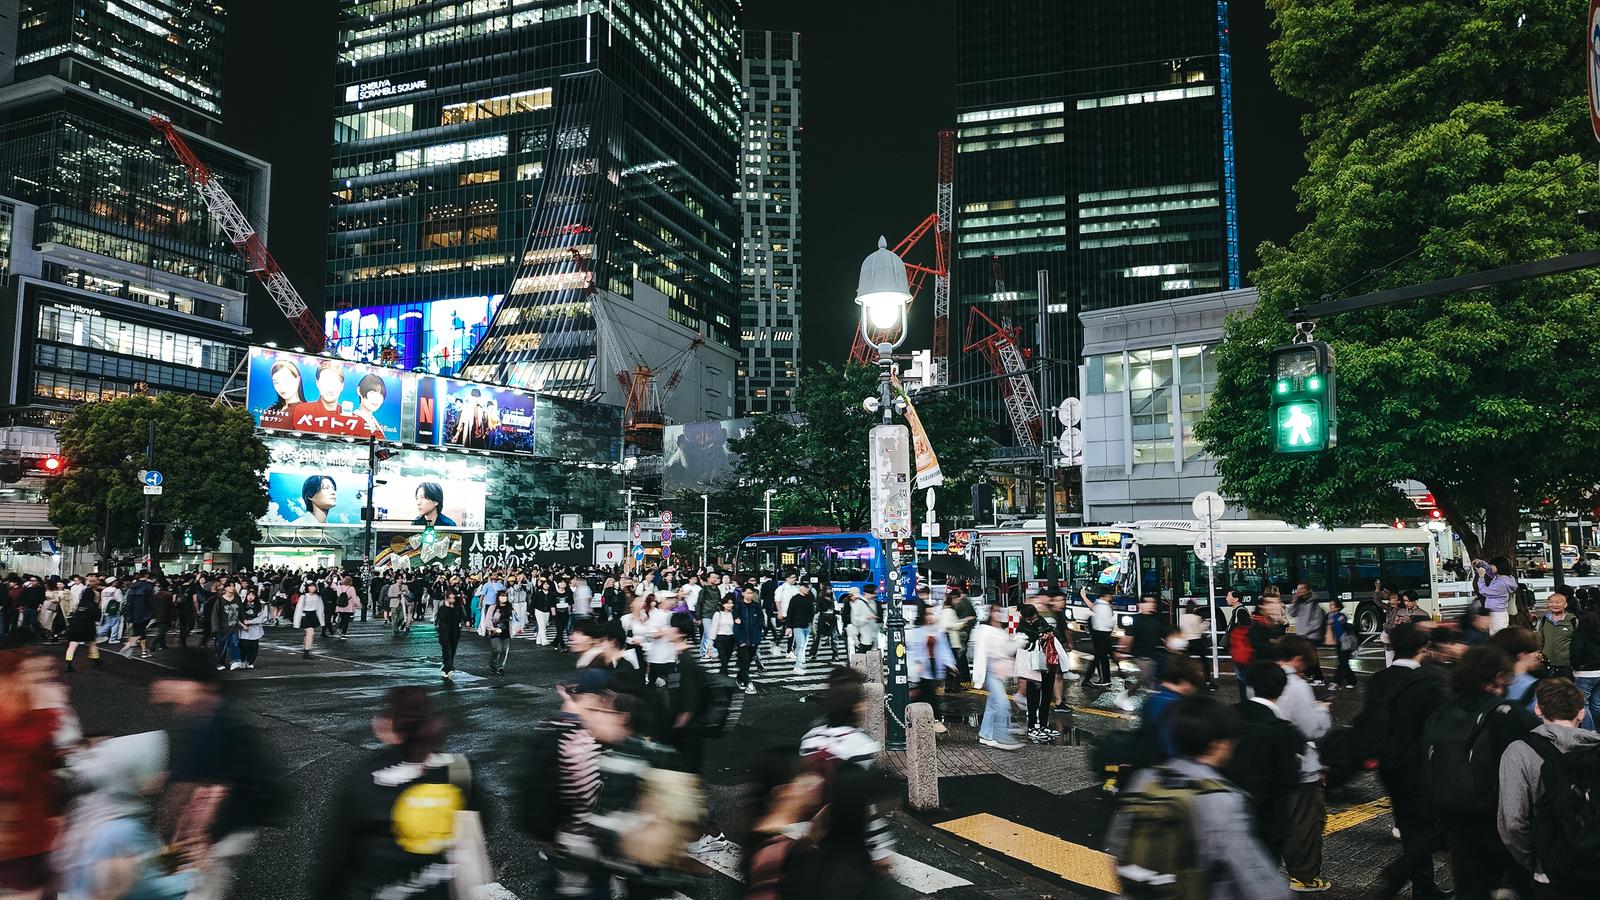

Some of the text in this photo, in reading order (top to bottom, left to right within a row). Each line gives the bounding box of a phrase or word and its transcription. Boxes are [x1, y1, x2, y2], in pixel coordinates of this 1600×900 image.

[360, 79, 390, 91] SHIBUYA
[360, 80, 427, 100] SCRAMBLE SQUARE
[70, 304, 101, 316] Hikarie
[297, 414, 358, 431] ペイトク
[468, 530, 585, 552] 人類よ、この惑星は
